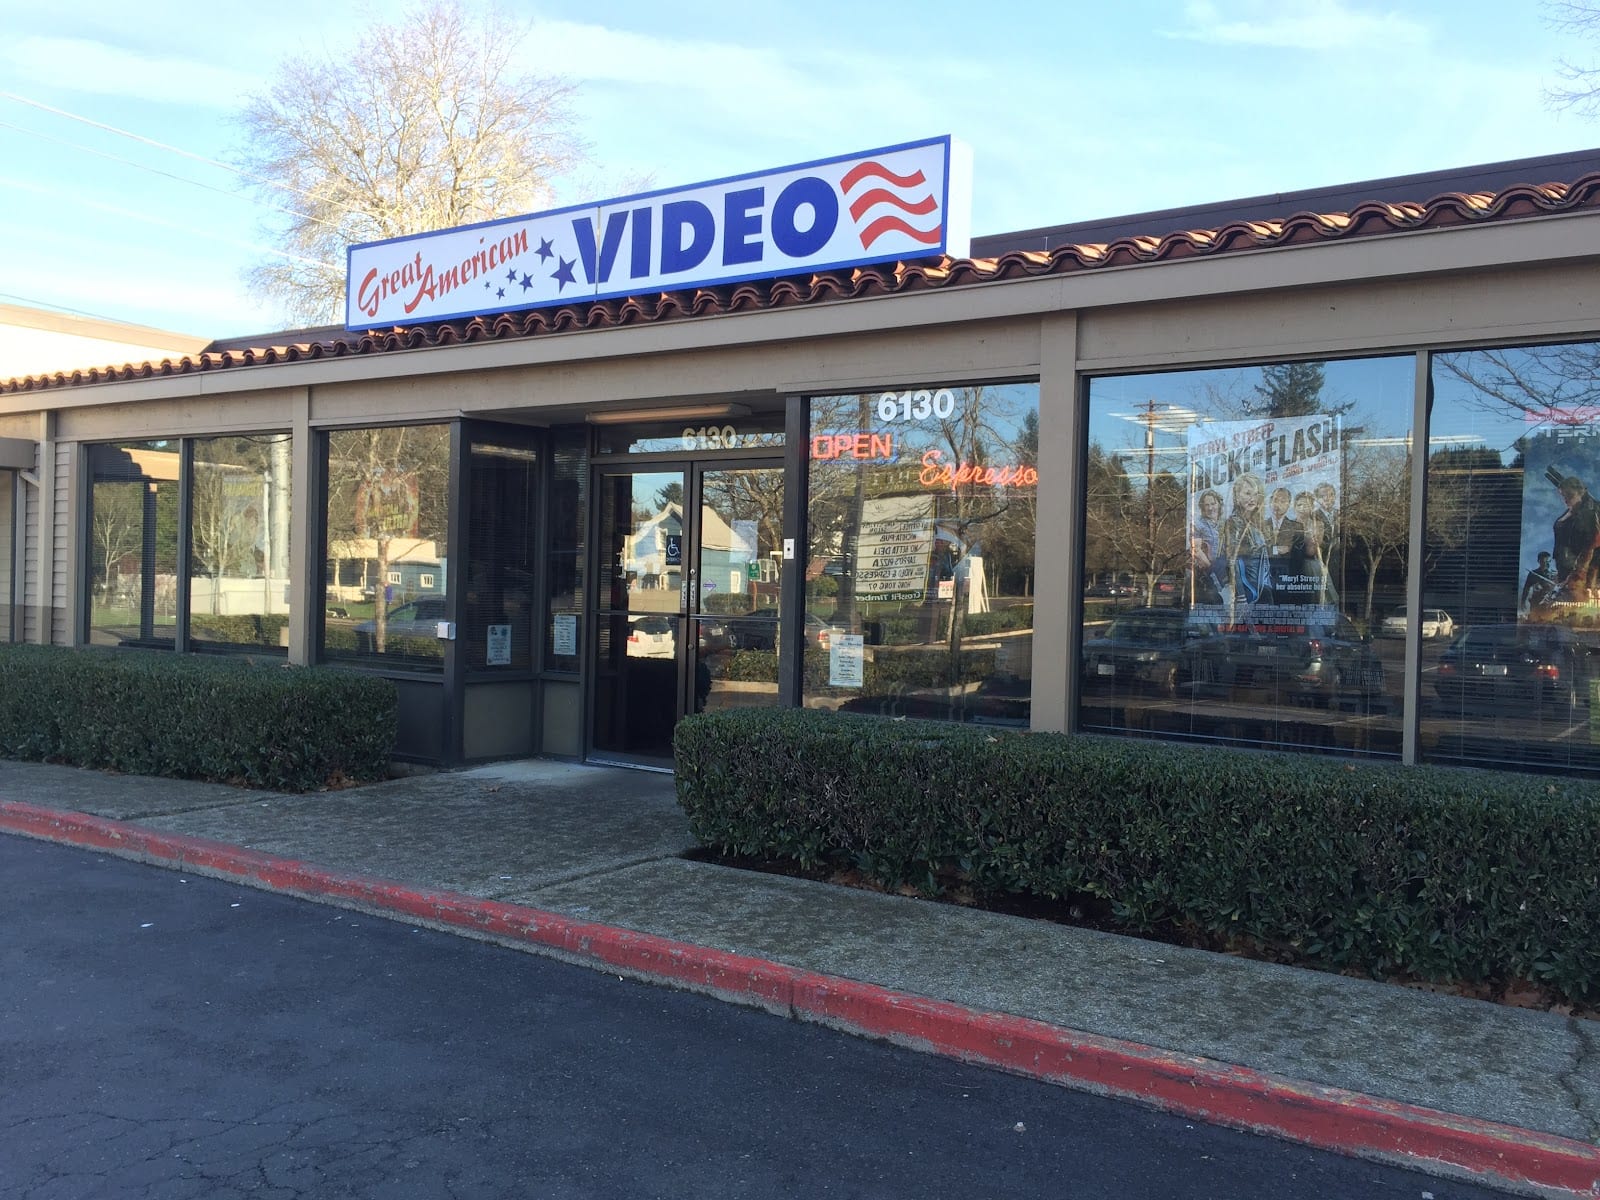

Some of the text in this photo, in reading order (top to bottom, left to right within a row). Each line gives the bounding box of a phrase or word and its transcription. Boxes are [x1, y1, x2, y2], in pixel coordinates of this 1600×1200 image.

[571, 177, 838, 285] VIDEO
[358, 228, 530, 318] Great American
[877, 388, 955, 422] 6130
[681, 424, 736, 452] 6130
[812, 434, 891, 459] OPEN
[1232, 422, 1275, 446] STREEP
[1265, 417, 1339, 471] FLASH
[919, 449, 1039, 491] Espresso
